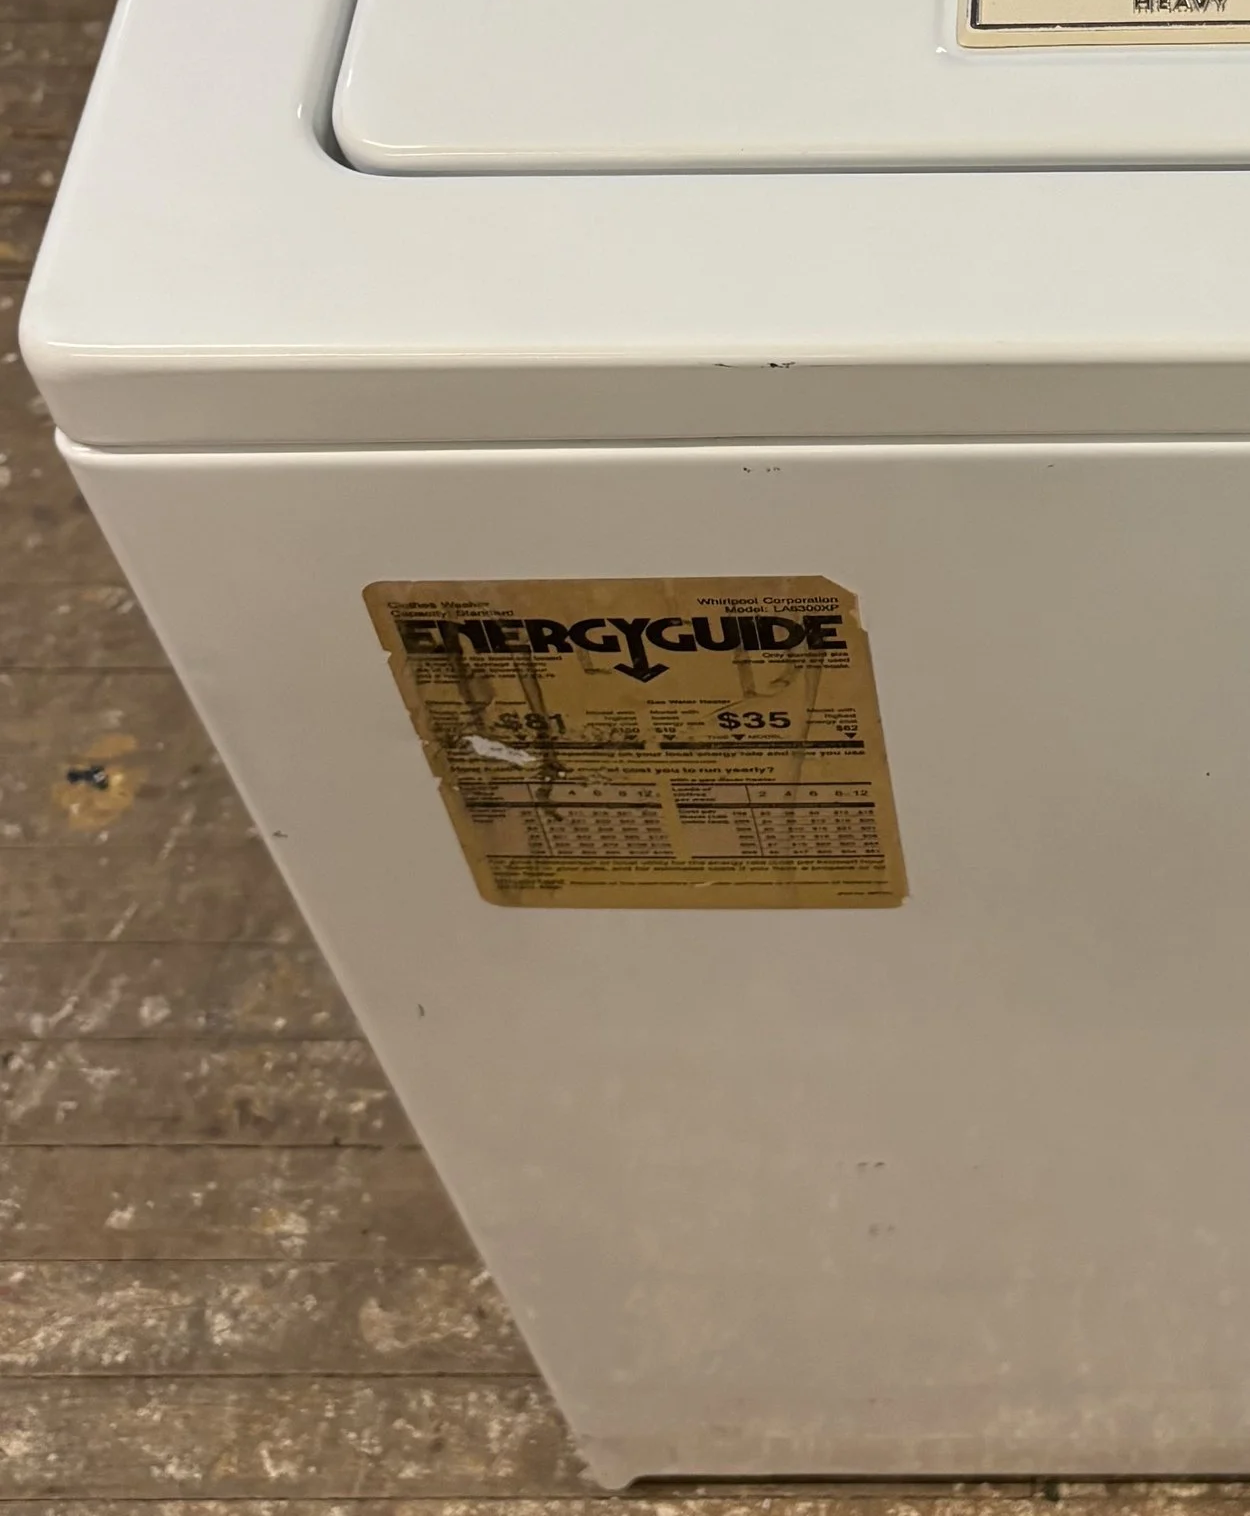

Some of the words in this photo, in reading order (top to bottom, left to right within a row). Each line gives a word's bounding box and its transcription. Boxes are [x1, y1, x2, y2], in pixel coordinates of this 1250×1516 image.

[697, 597, 758, 605] Whirlpool
[763, 596, 839, 606] Corporation
[725, 605, 769, 613] Model:
[395, 614, 848, 653] ENERGYGUIDE
[717, 711, 791, 731] $35
